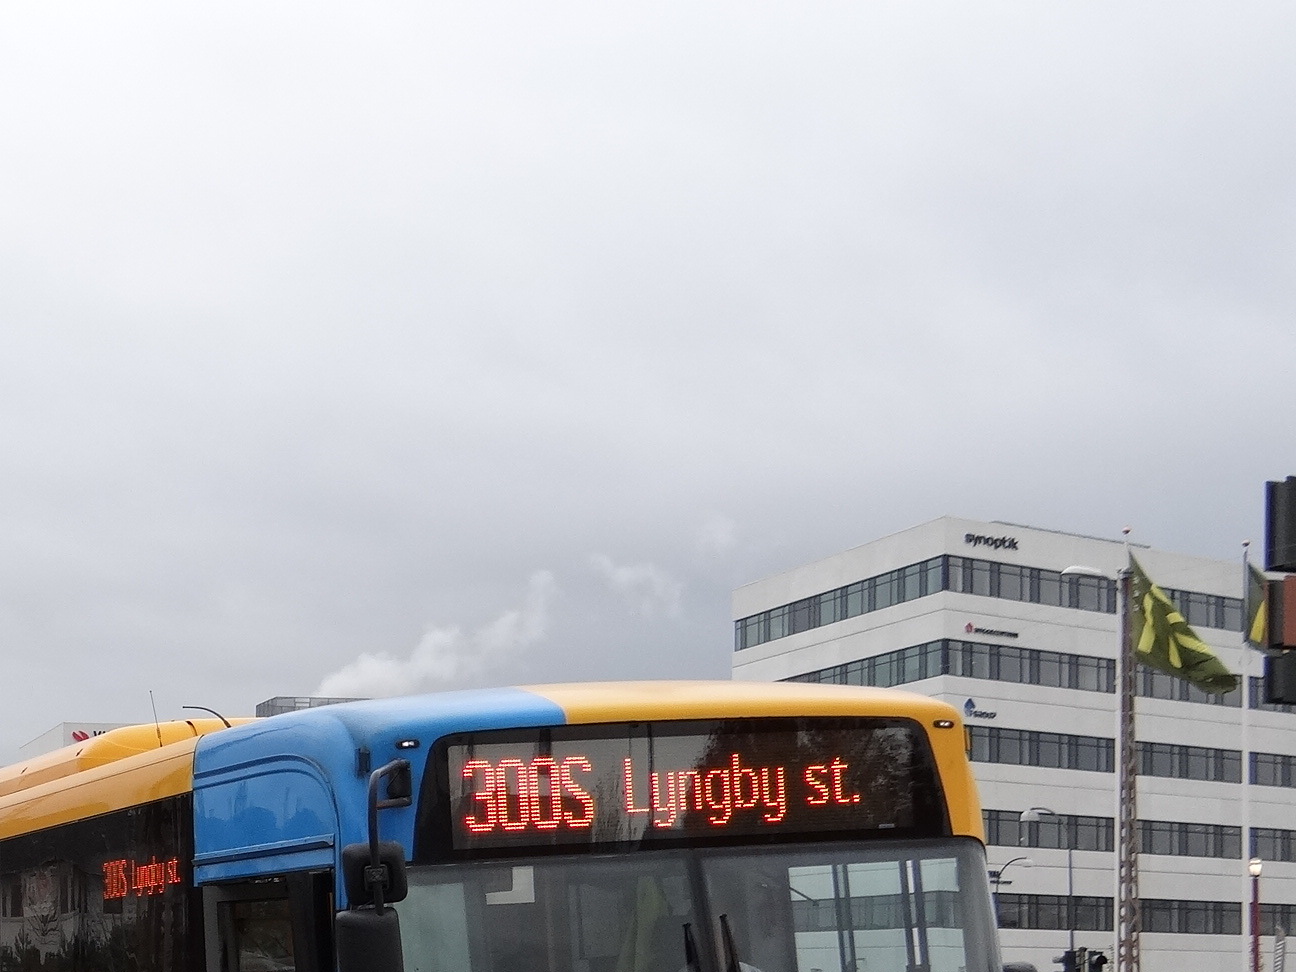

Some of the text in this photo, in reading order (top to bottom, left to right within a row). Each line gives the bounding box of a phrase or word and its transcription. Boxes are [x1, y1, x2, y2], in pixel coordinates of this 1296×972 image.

[964, 533, 1019, 551] synoptik
[462, 753, 861, 832] 300S Lyngby st.
